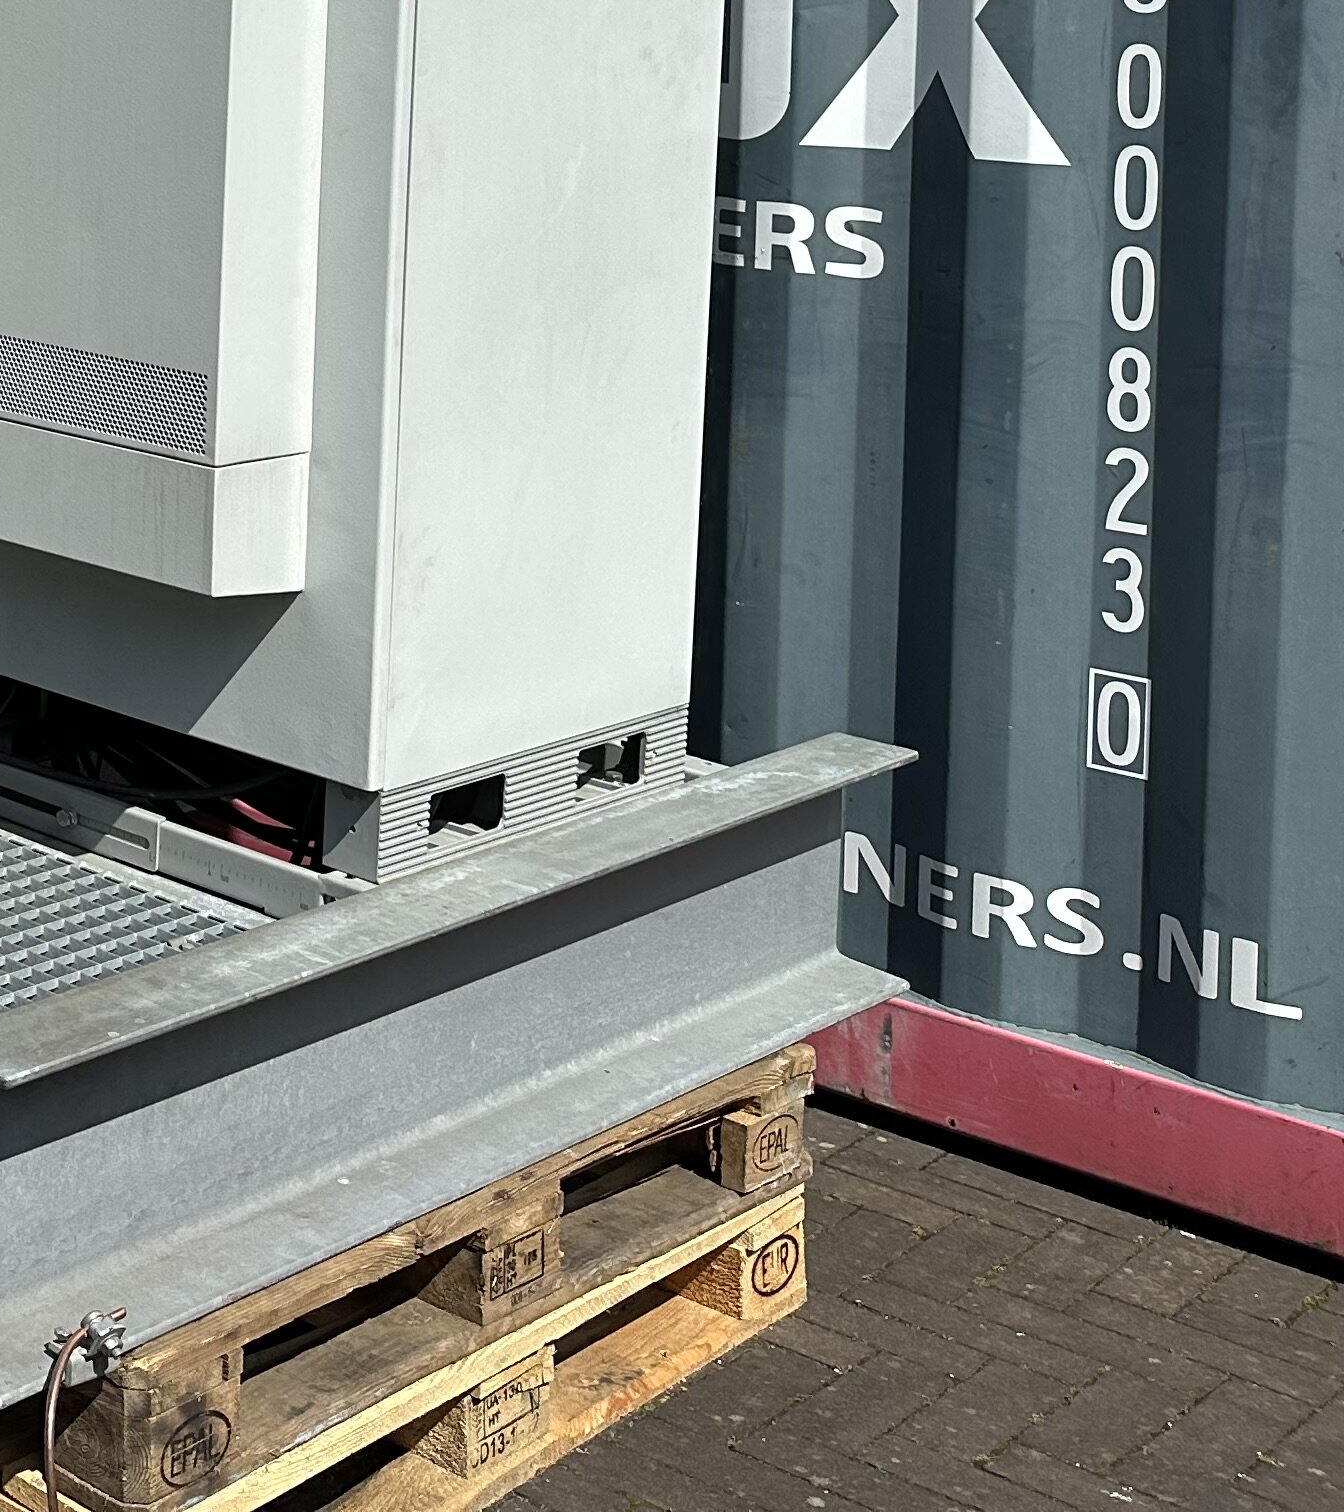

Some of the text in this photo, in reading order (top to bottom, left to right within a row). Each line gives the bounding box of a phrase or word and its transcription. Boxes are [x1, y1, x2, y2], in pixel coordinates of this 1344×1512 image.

[712, 195, 886, 280] ERS
[1100, 42, 1163, 634] 000823
[843, 831, 1303, 1021] NERS.NL
[759, 1124, 790, 1165] EPAL
[761, 1241, 789, 1289] EUR
[488, 1409, 502, 1428] HT
[170, 1422, 221, 1479] EPAL
